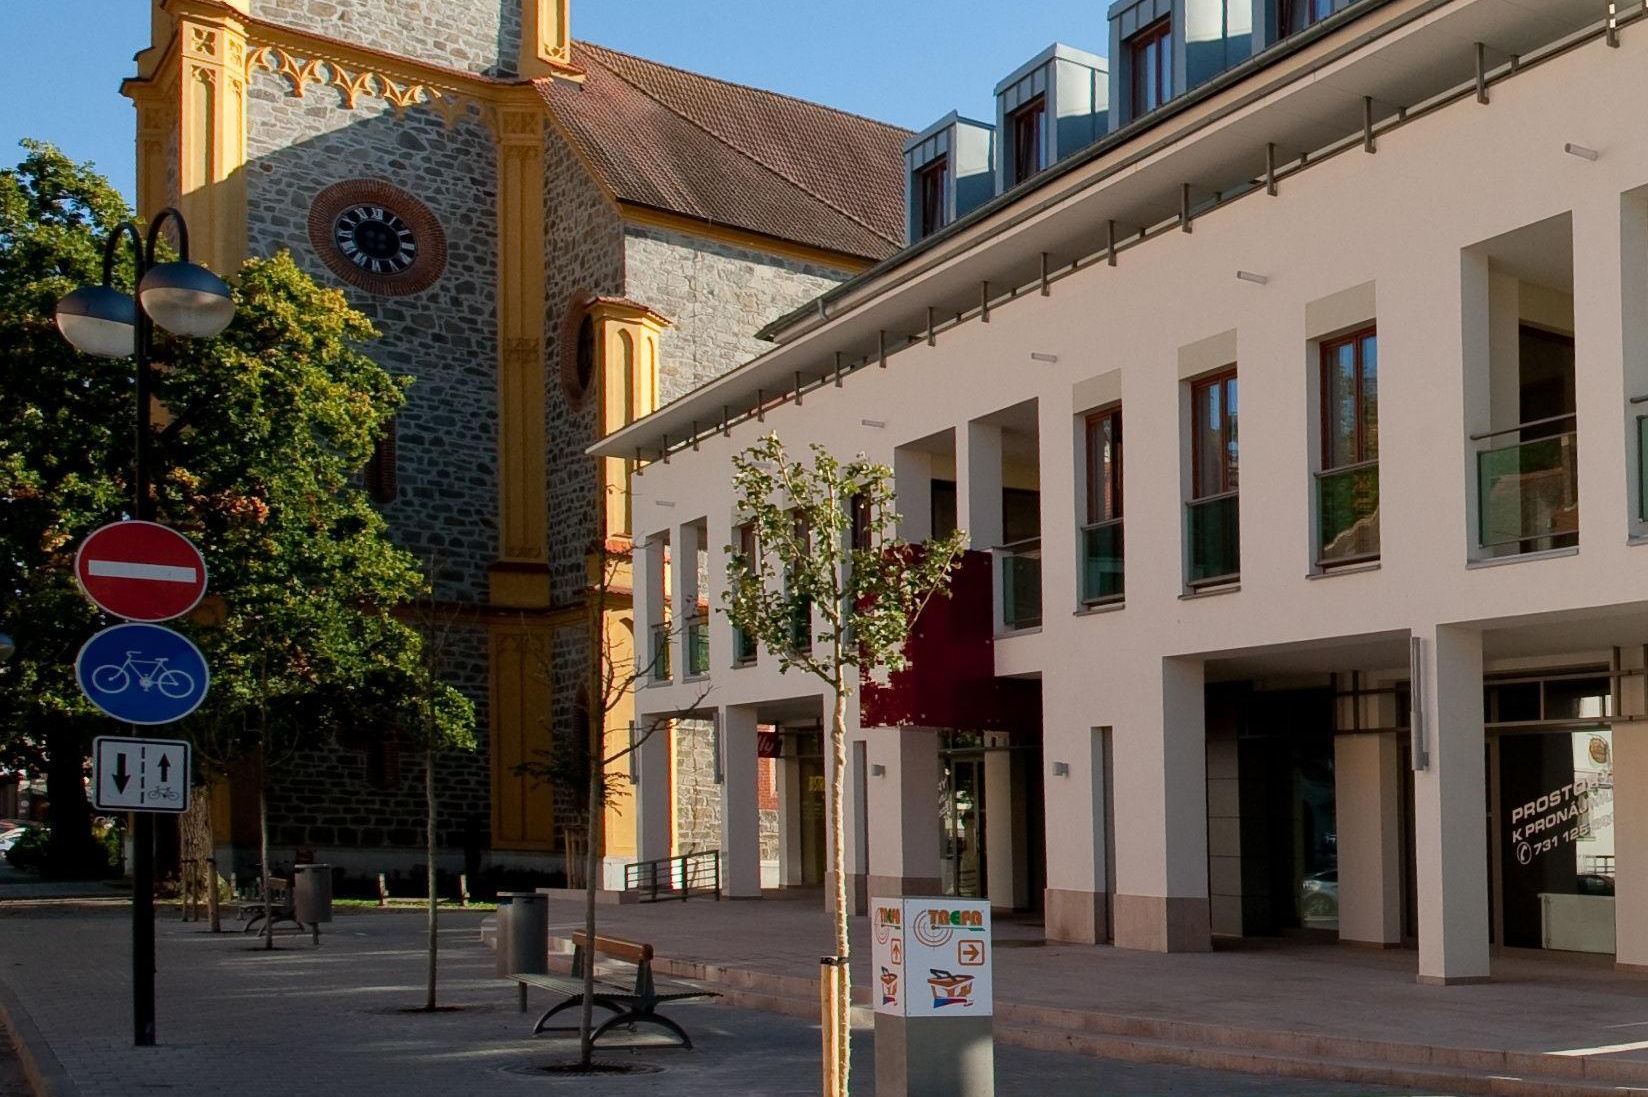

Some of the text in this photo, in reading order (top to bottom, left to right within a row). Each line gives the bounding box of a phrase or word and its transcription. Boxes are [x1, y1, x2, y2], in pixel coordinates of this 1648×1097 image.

[1512, 769, 1612, 824] PROSTO
[1512, 828, 1523, 843] K
[1533, 823, 1591, 857] 731 125
[928, 909, 983, 926] TREFA
